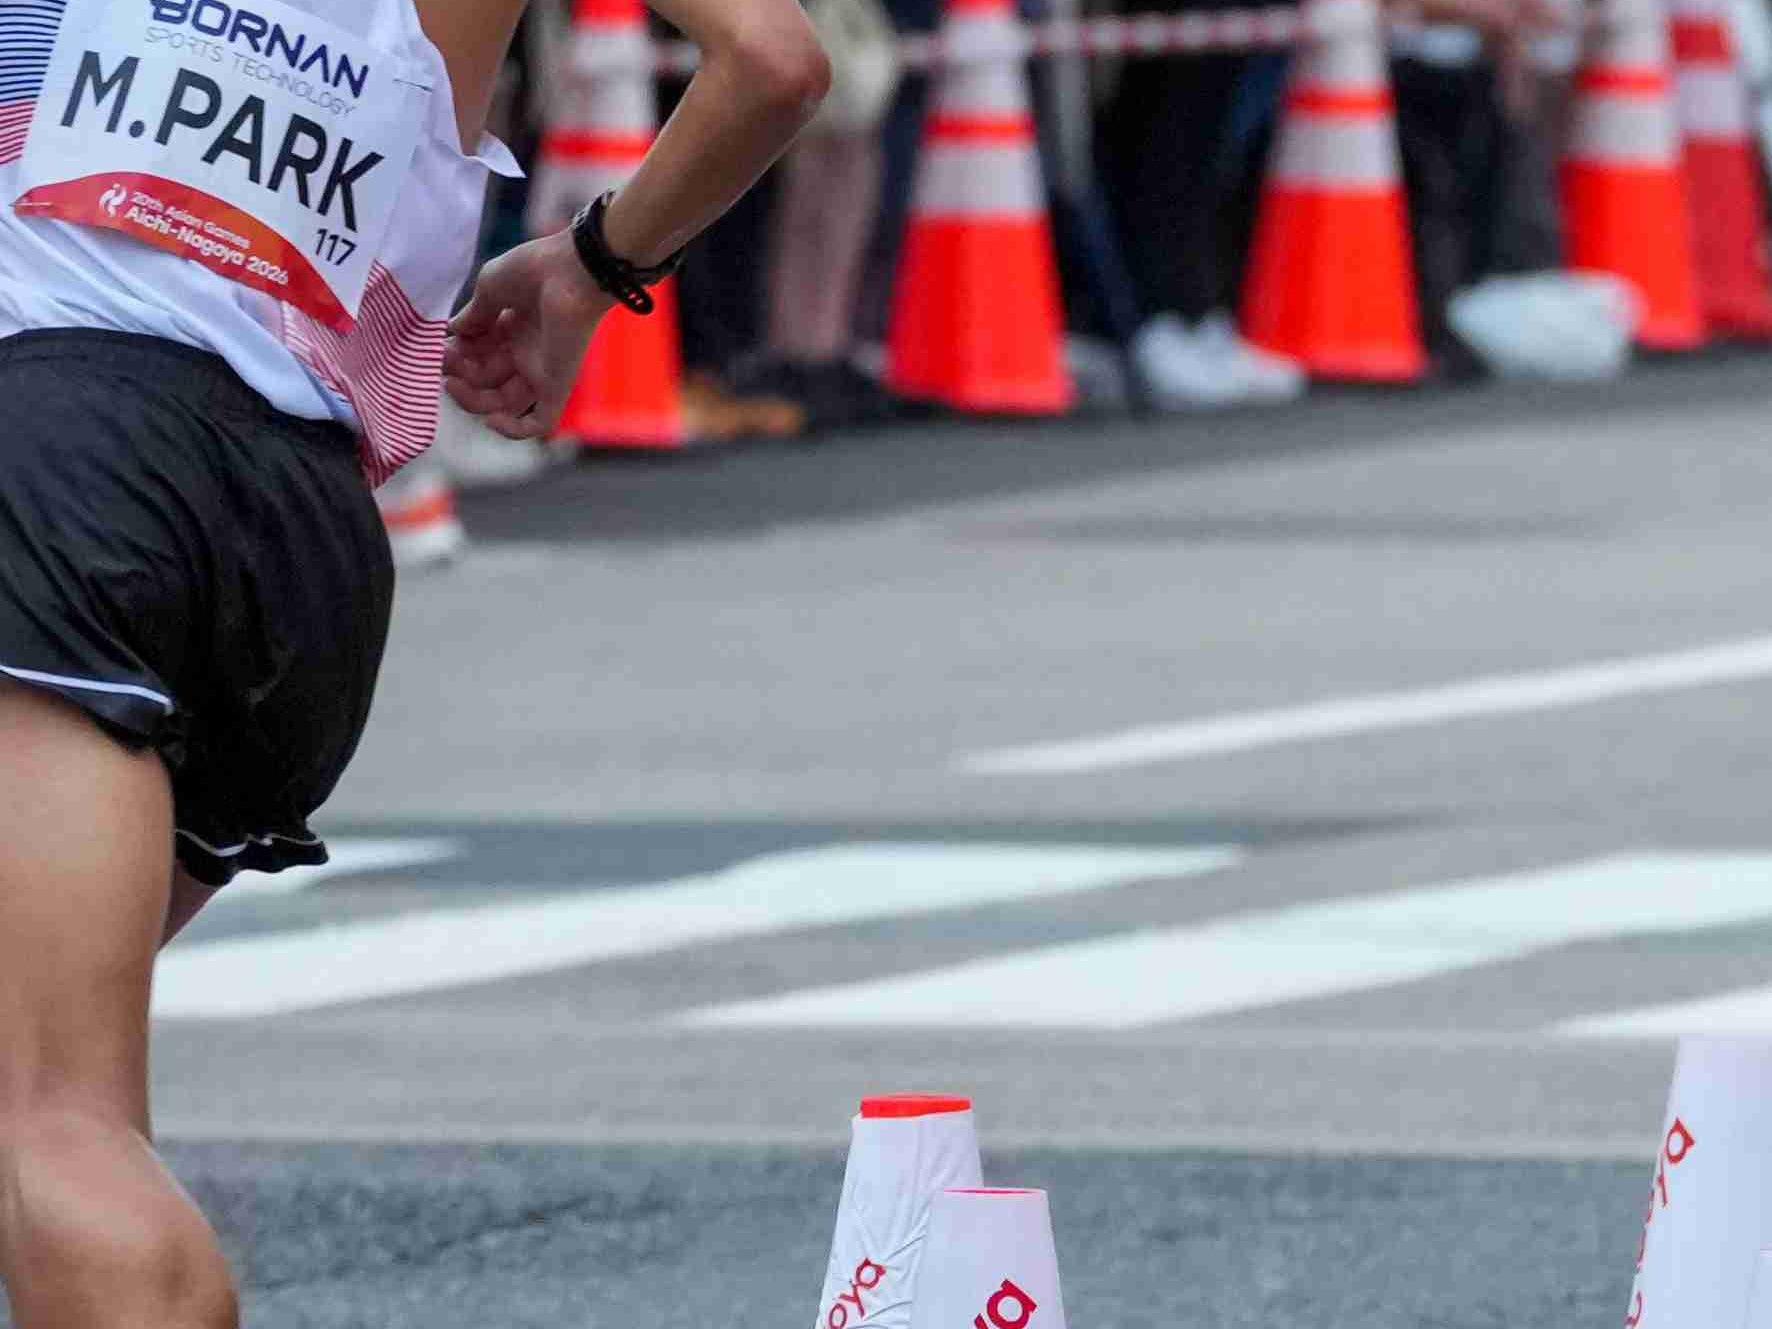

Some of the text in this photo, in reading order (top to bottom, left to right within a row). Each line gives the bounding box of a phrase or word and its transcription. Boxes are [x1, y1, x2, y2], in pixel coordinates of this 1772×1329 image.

[144, 26, 225, 63] SPORTS
[61, 49, 385, 233] M.PARK
[125, 205, 290, 286] Aichi-Nagoya 2026
[315, 228, 358, 267] 117
